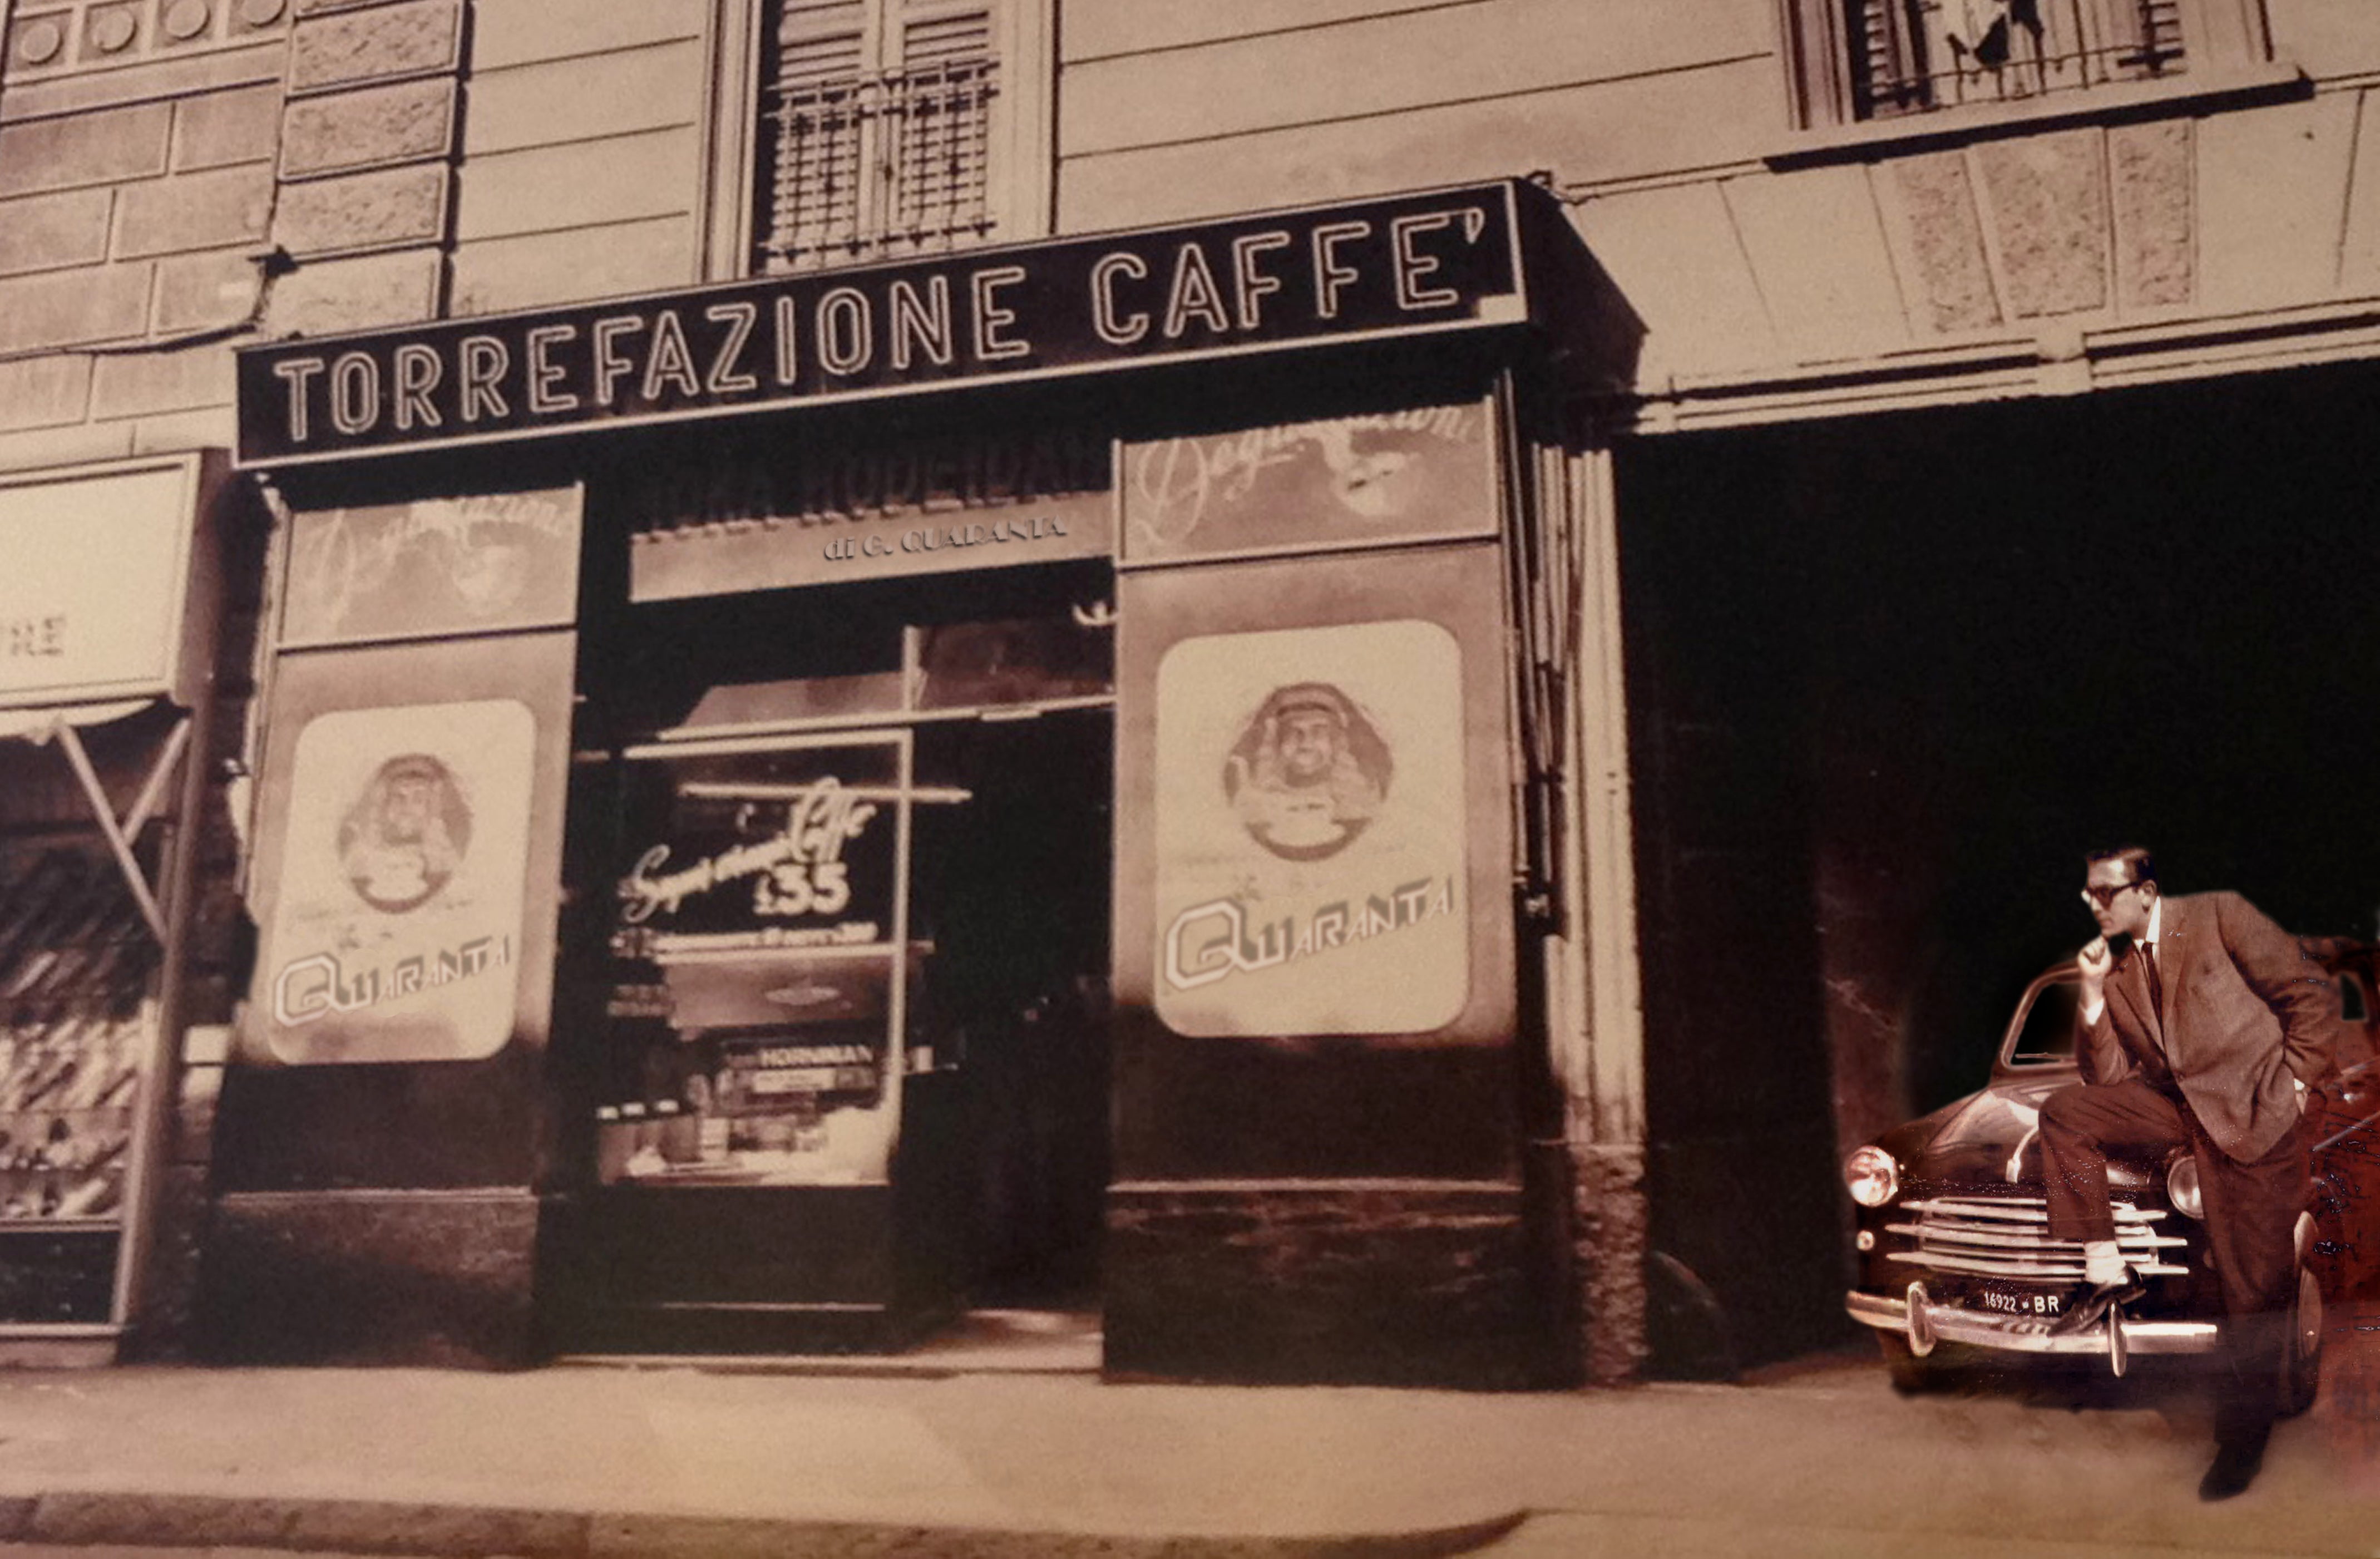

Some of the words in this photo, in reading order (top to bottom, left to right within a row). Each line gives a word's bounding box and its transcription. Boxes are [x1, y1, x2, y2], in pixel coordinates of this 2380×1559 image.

[273, 265, 1031, 445] TORREFAZIONE
[1090, 206, 1485, 346] CAFFE'
[823, 537, 856, 561] di
[901, 515, 1068, 553] QUARANTA
[1983, 1290, 2017, 1313] 16922
[2033, 1295, 2060, 1314] BR
